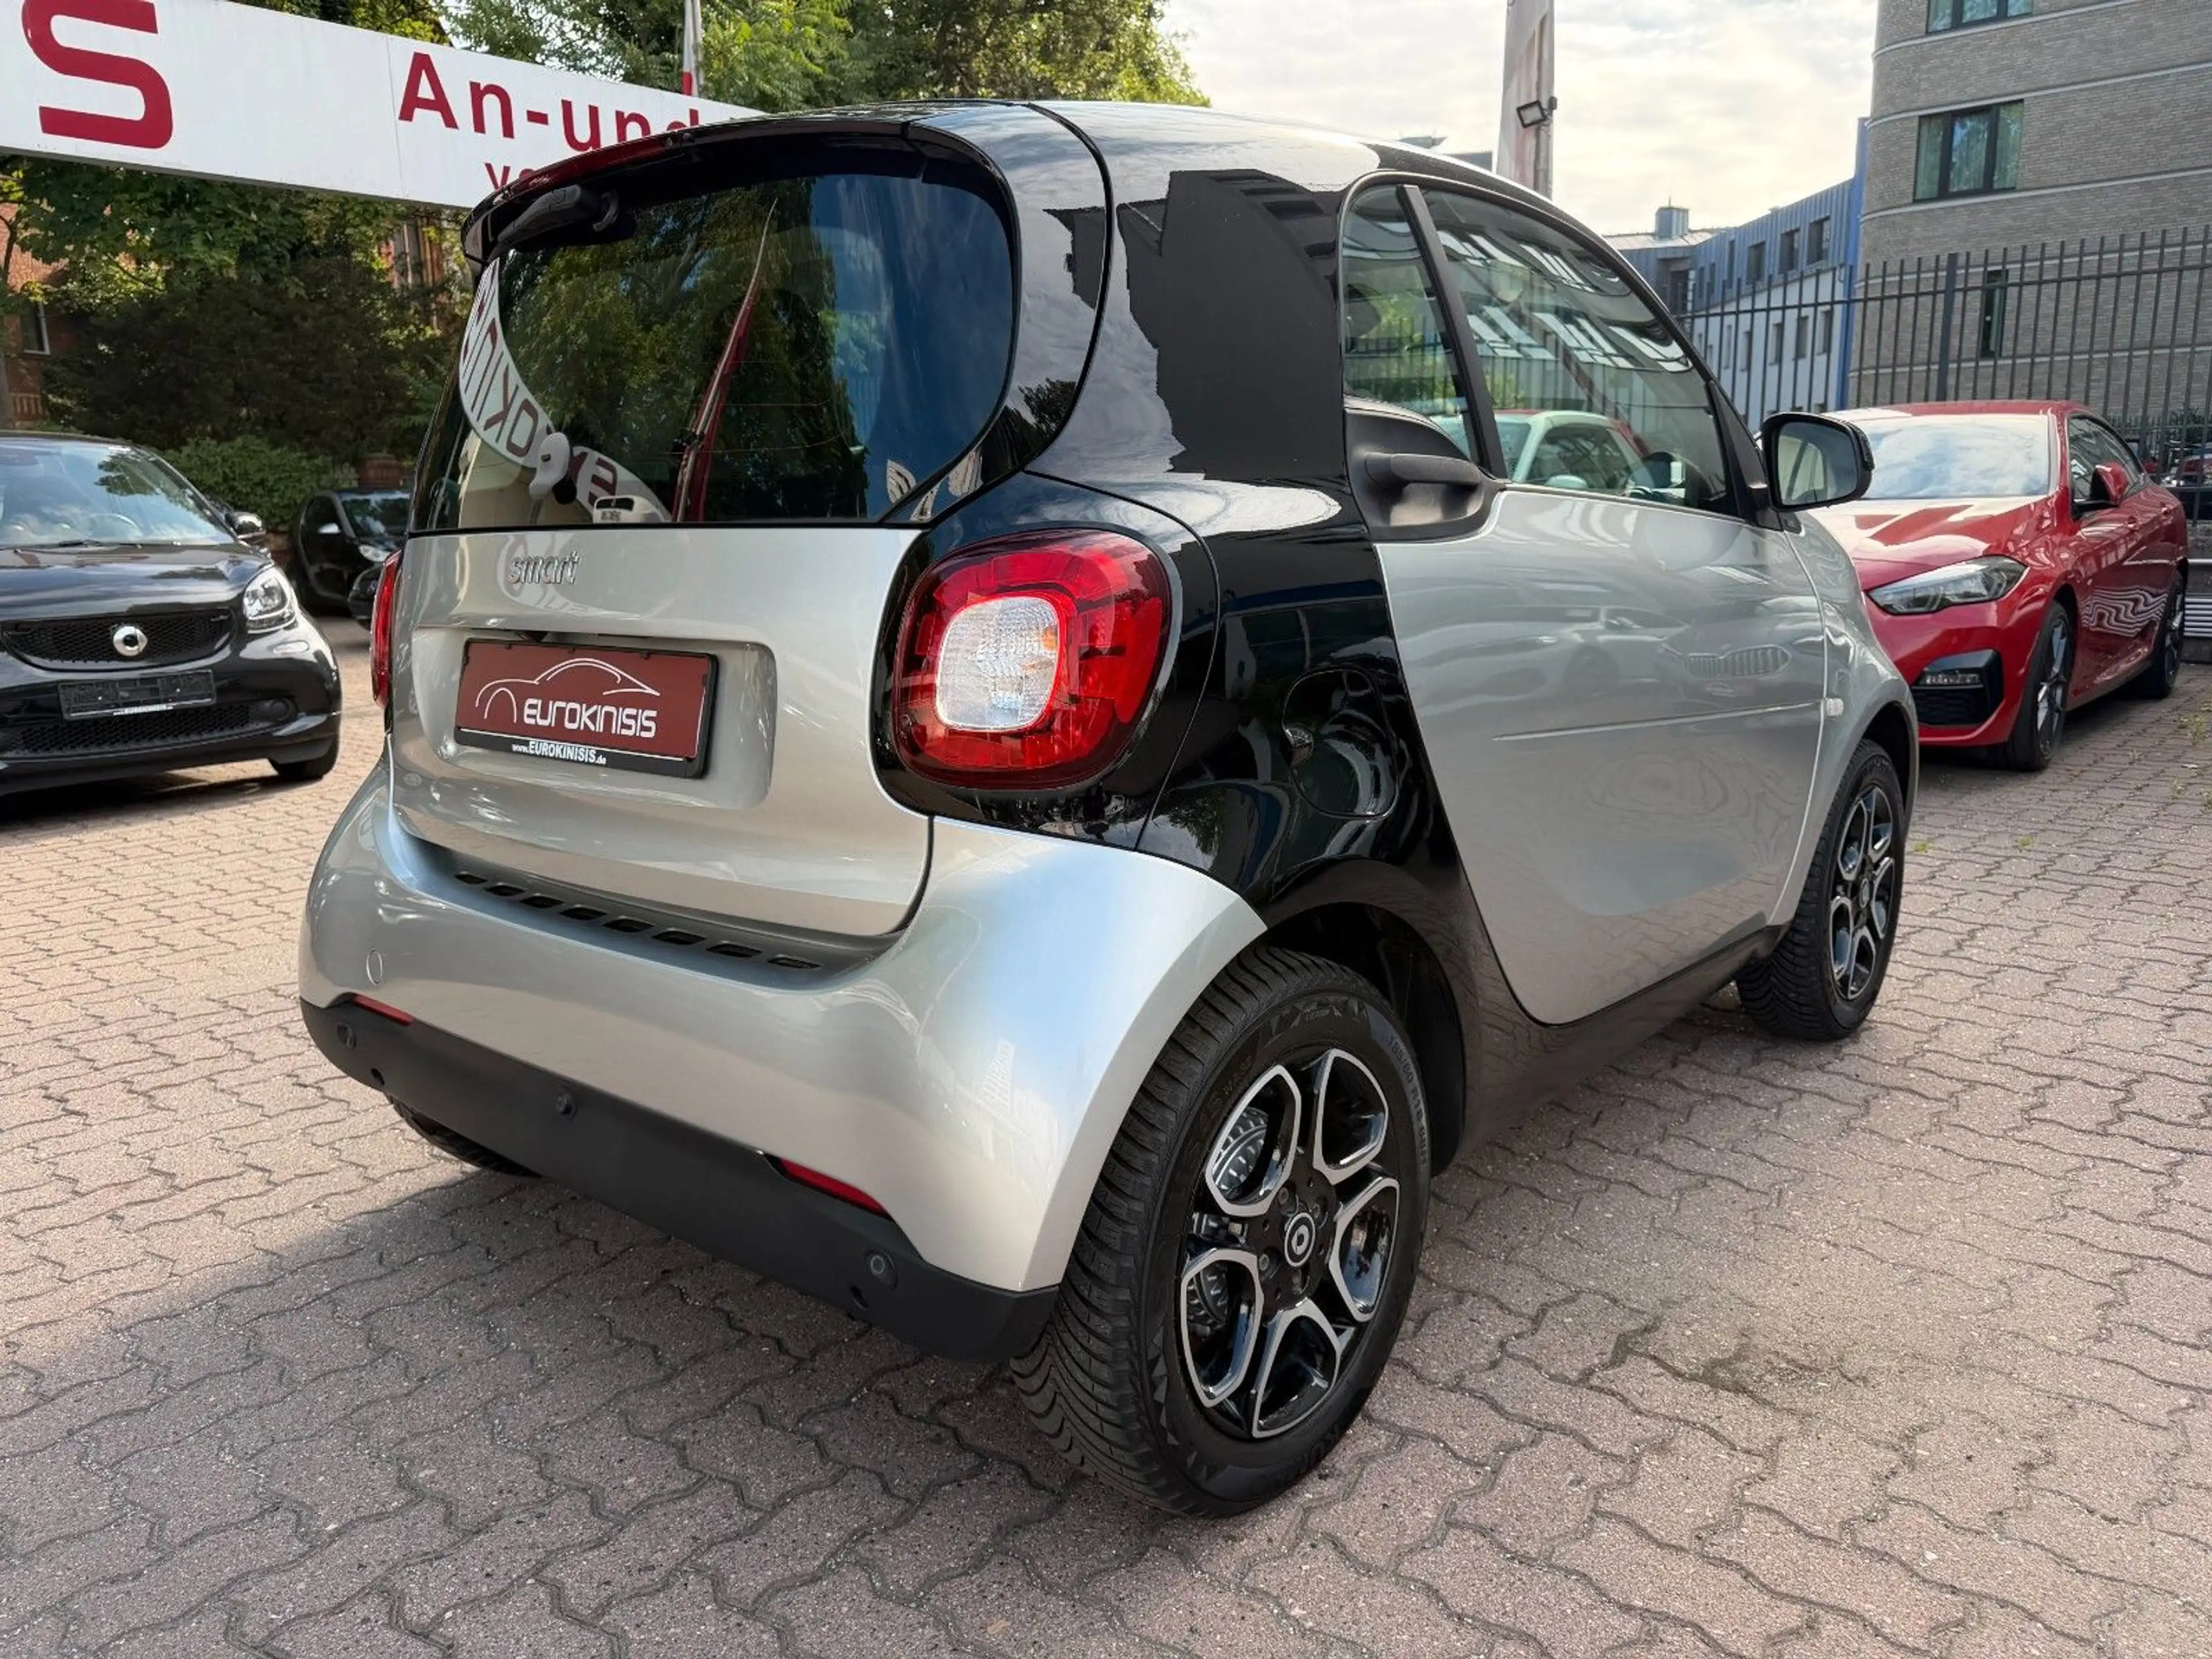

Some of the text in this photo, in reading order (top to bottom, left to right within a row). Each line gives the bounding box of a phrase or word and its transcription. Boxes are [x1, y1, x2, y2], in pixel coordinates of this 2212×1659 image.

[22, 0, 173, 149] S
[509, 550, 579, 585] smart
[524, 698, 657, 738] EUROKINISIS
[512, 741, 607, 766] www.EUROKINISIS.de
